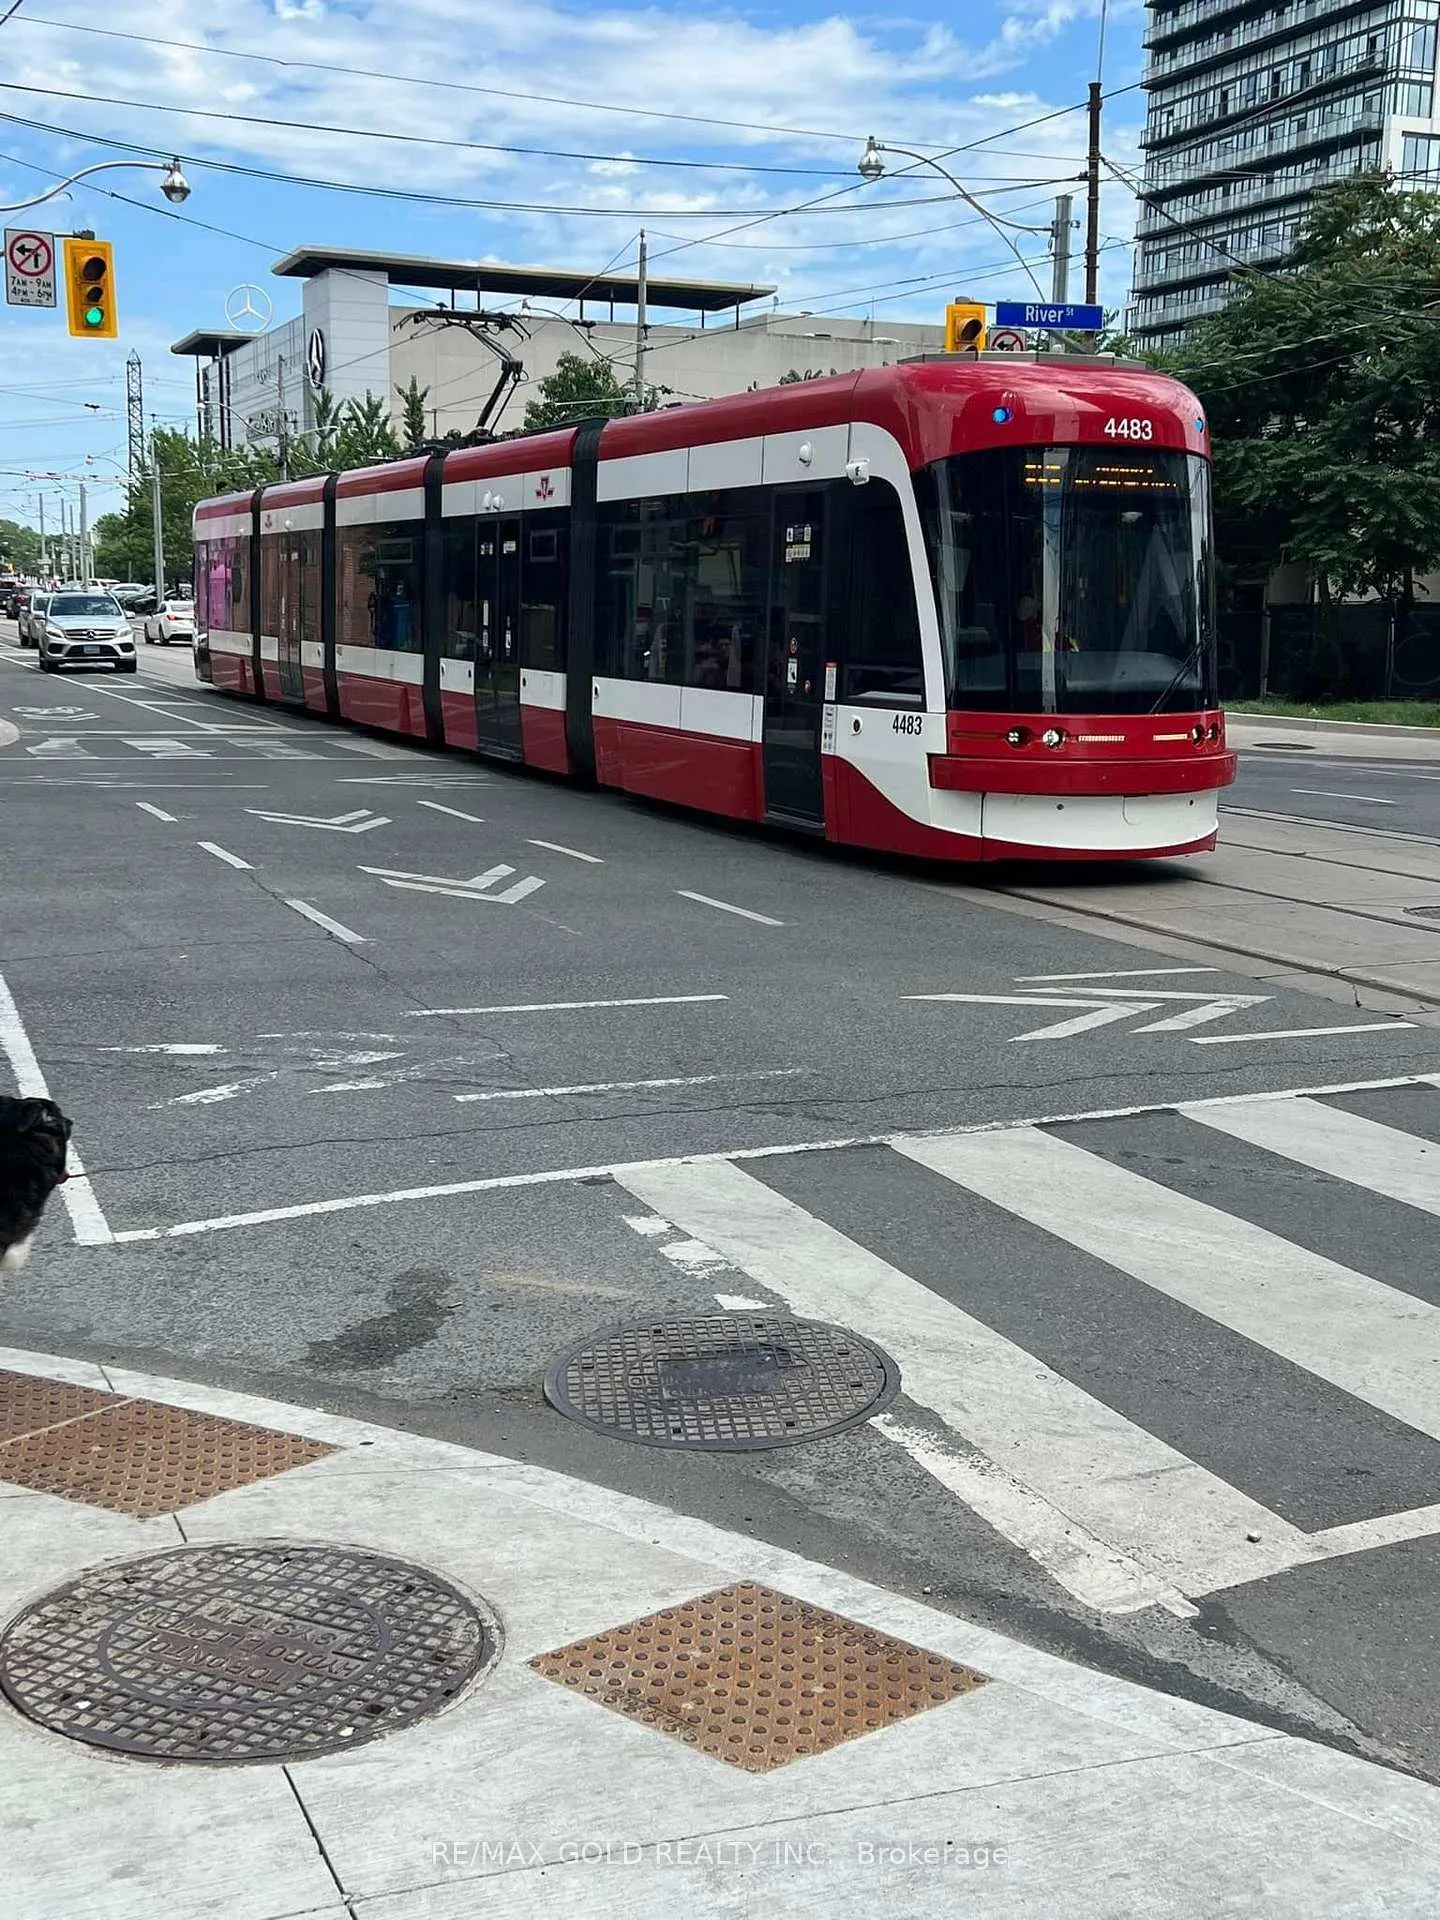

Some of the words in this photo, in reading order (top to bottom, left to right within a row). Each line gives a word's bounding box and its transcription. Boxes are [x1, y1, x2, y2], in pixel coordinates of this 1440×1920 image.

[1025, 305, 1064, 323] River
[1066, 307, 1074, 316] St
[1104, 417, 1152, 440] 4483
[892, 714, 922, 736] 4483
